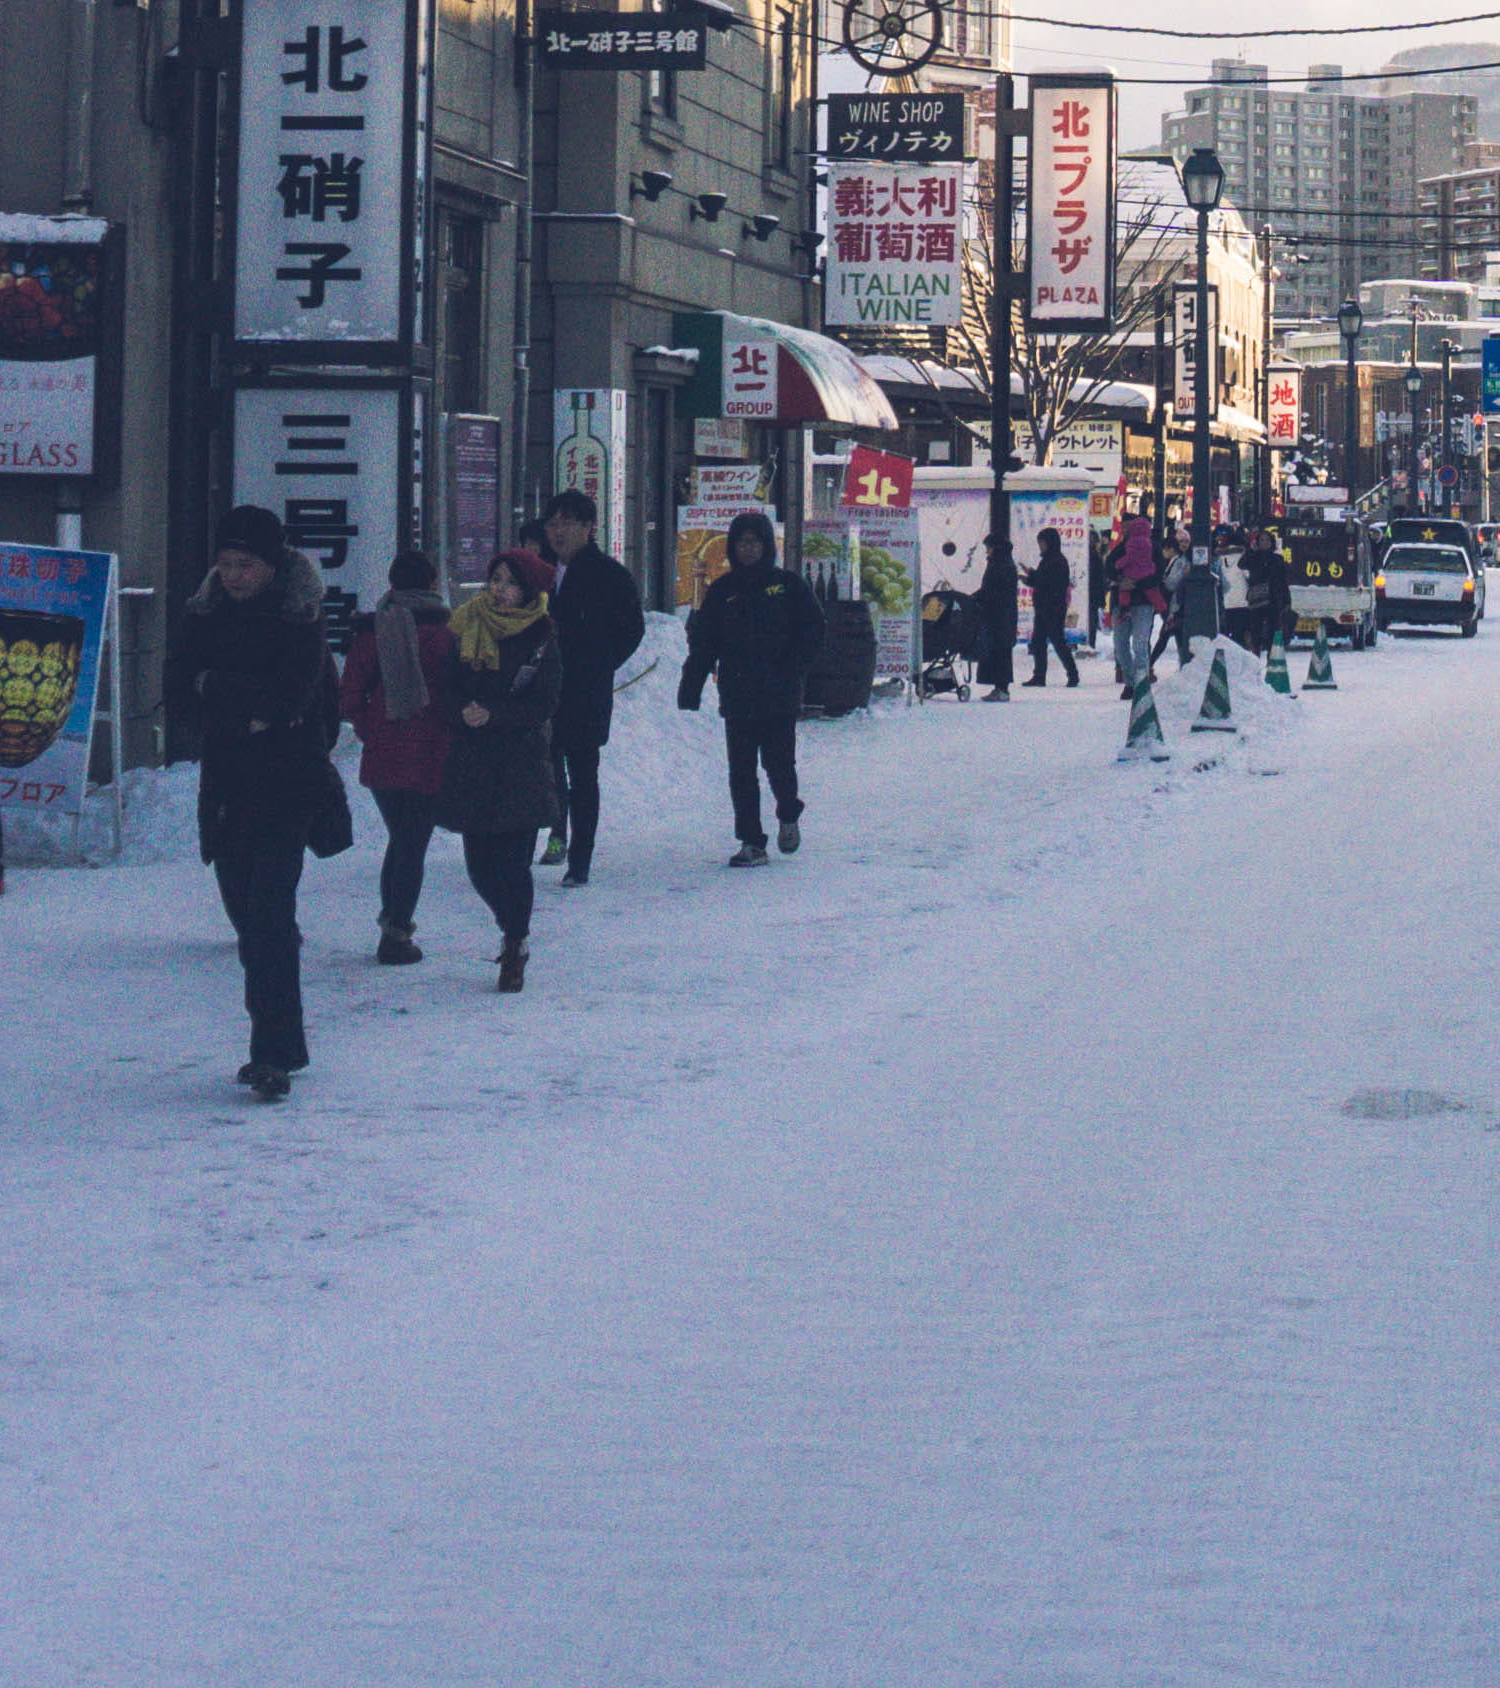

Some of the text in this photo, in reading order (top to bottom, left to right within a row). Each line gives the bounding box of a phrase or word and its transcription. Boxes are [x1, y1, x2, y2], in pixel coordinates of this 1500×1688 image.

[546, 28, 699, 54] 北一硝子三号館
[848, 100, 945, 124] WINE SHOP
[837, 130, 953, 154] ヴィノテカ
[276, 25, 369, 310] 北一硝子
[835, 176, 956, 218] 義大利
[1052, 100, 1092, 275] 北一プラザ
[833, 222, 956, 264] 葡萄酒
[839, 273, 951, 298] ITALIAN
[1037, 286, 1100, 305] PLAZA
[856, 297, 932, 322] WINE
[726, 400, 773, 416] GROUP
[1270, 380, 1297, 440] 地酒
[1305, 561, 1344, 578] いも
